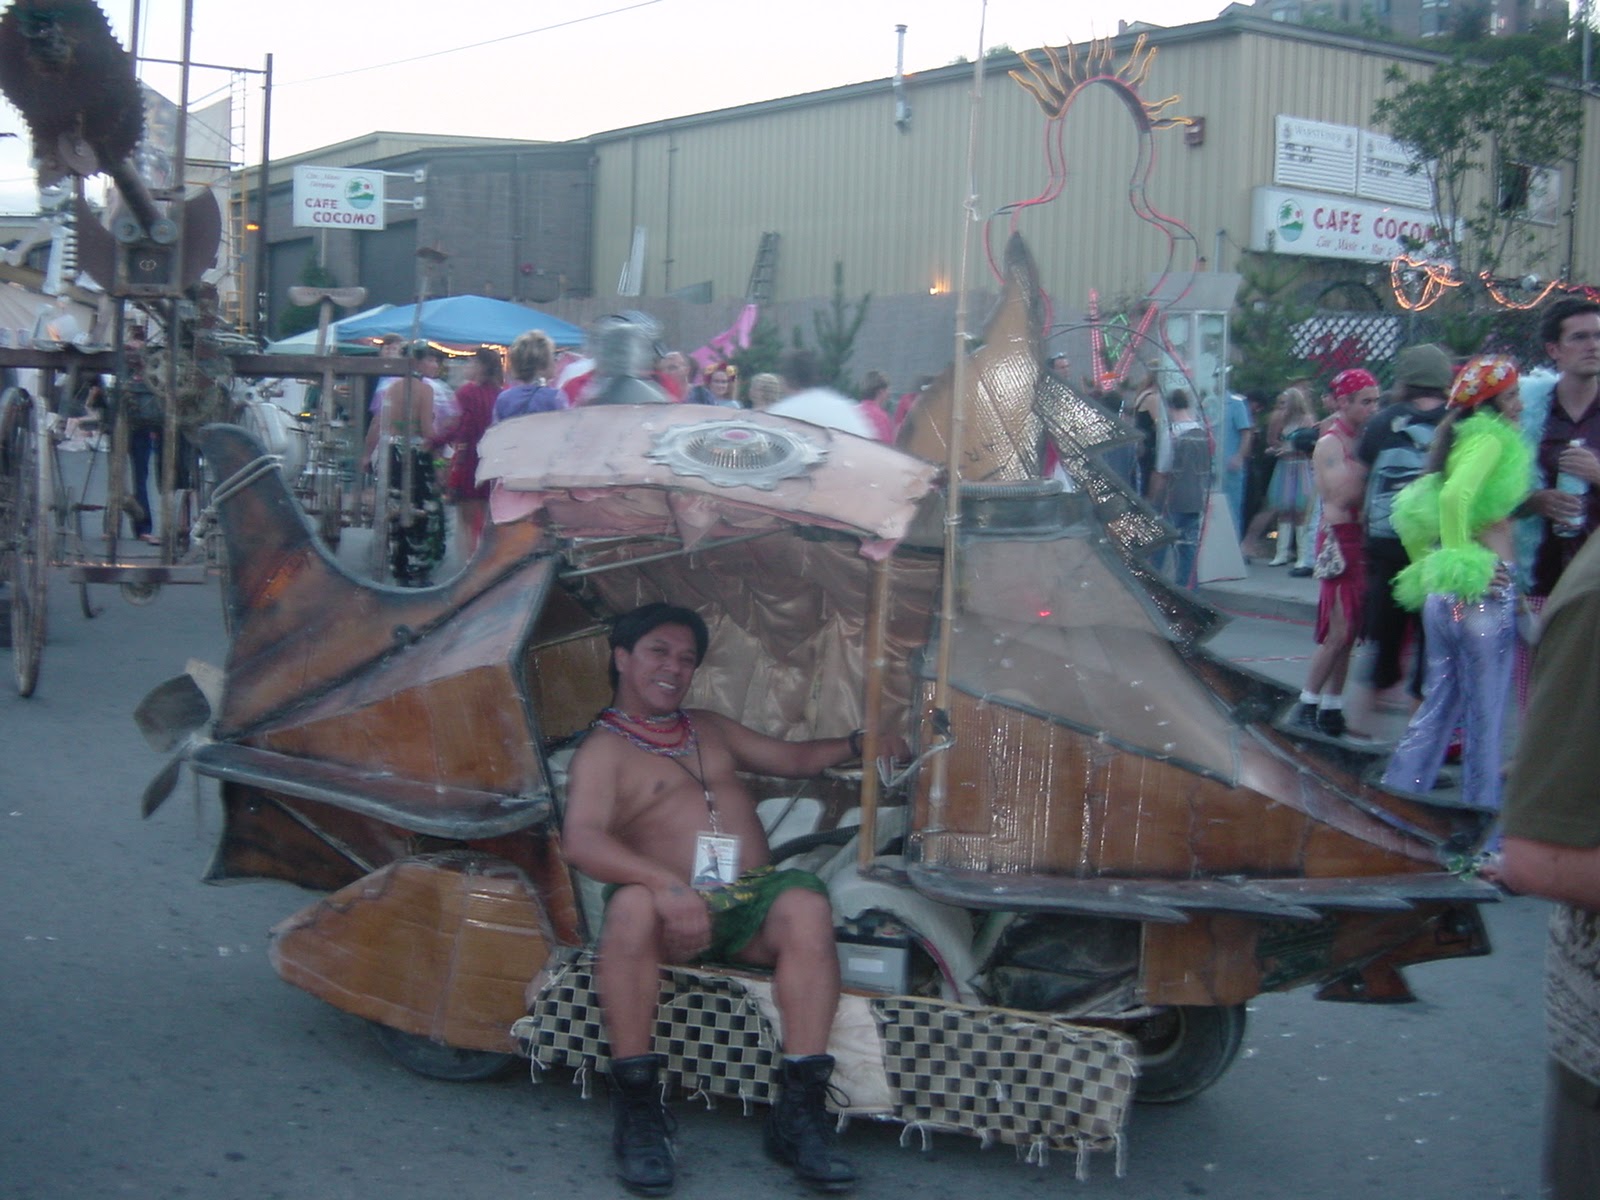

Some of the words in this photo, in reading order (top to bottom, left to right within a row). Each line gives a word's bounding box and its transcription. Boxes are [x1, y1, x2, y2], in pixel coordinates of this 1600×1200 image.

[304, 198, 338, 209] CAFE
[312, 211, 376, 225] COCOMO
[1313, 207, 1362, 234] CAFE
[1373, 217, 1451, 246] COCO
